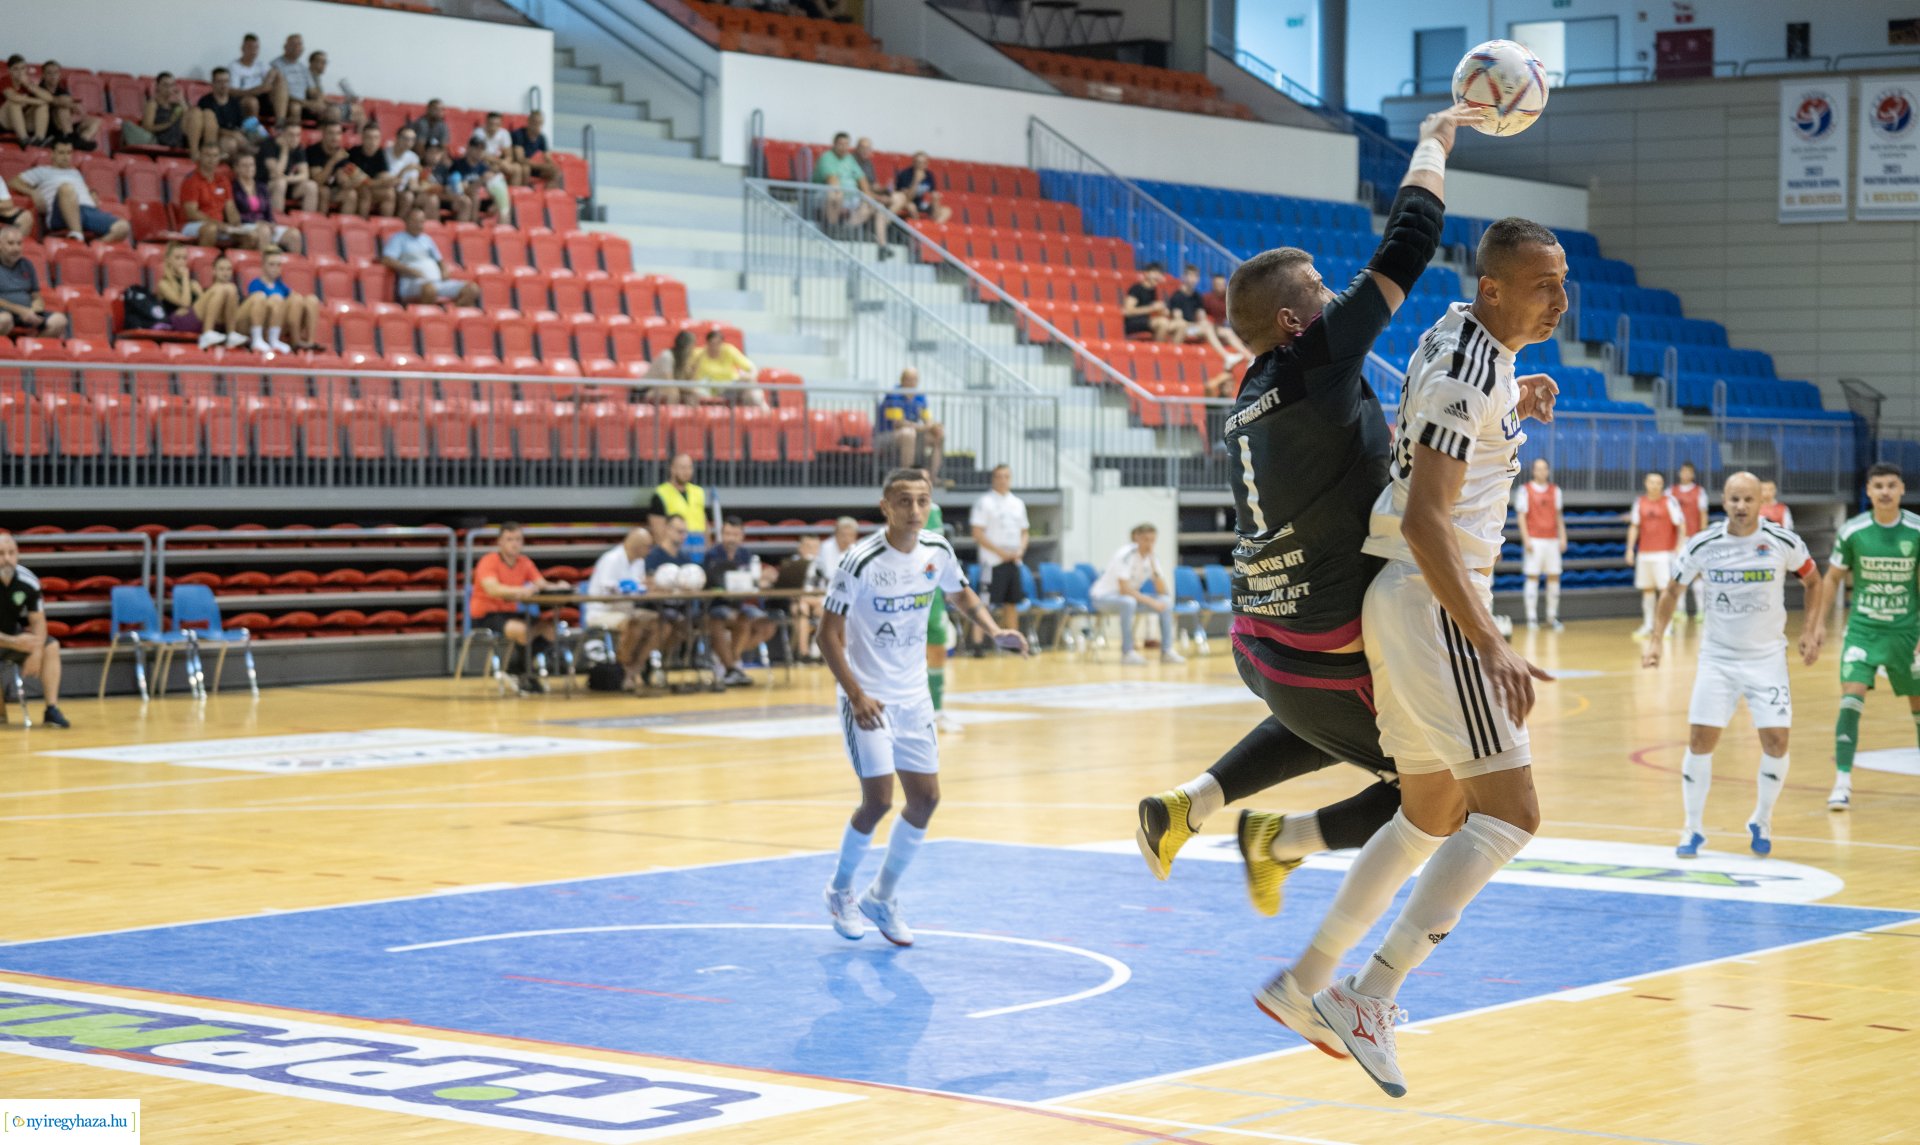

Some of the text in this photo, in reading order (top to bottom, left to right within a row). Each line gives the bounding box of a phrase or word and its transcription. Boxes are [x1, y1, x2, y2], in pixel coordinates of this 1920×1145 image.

[1238, 435, 1268, 538] 1
[1282, 549, 1305, 568] KFT
[1286, 581, 1311, 600] KFT
